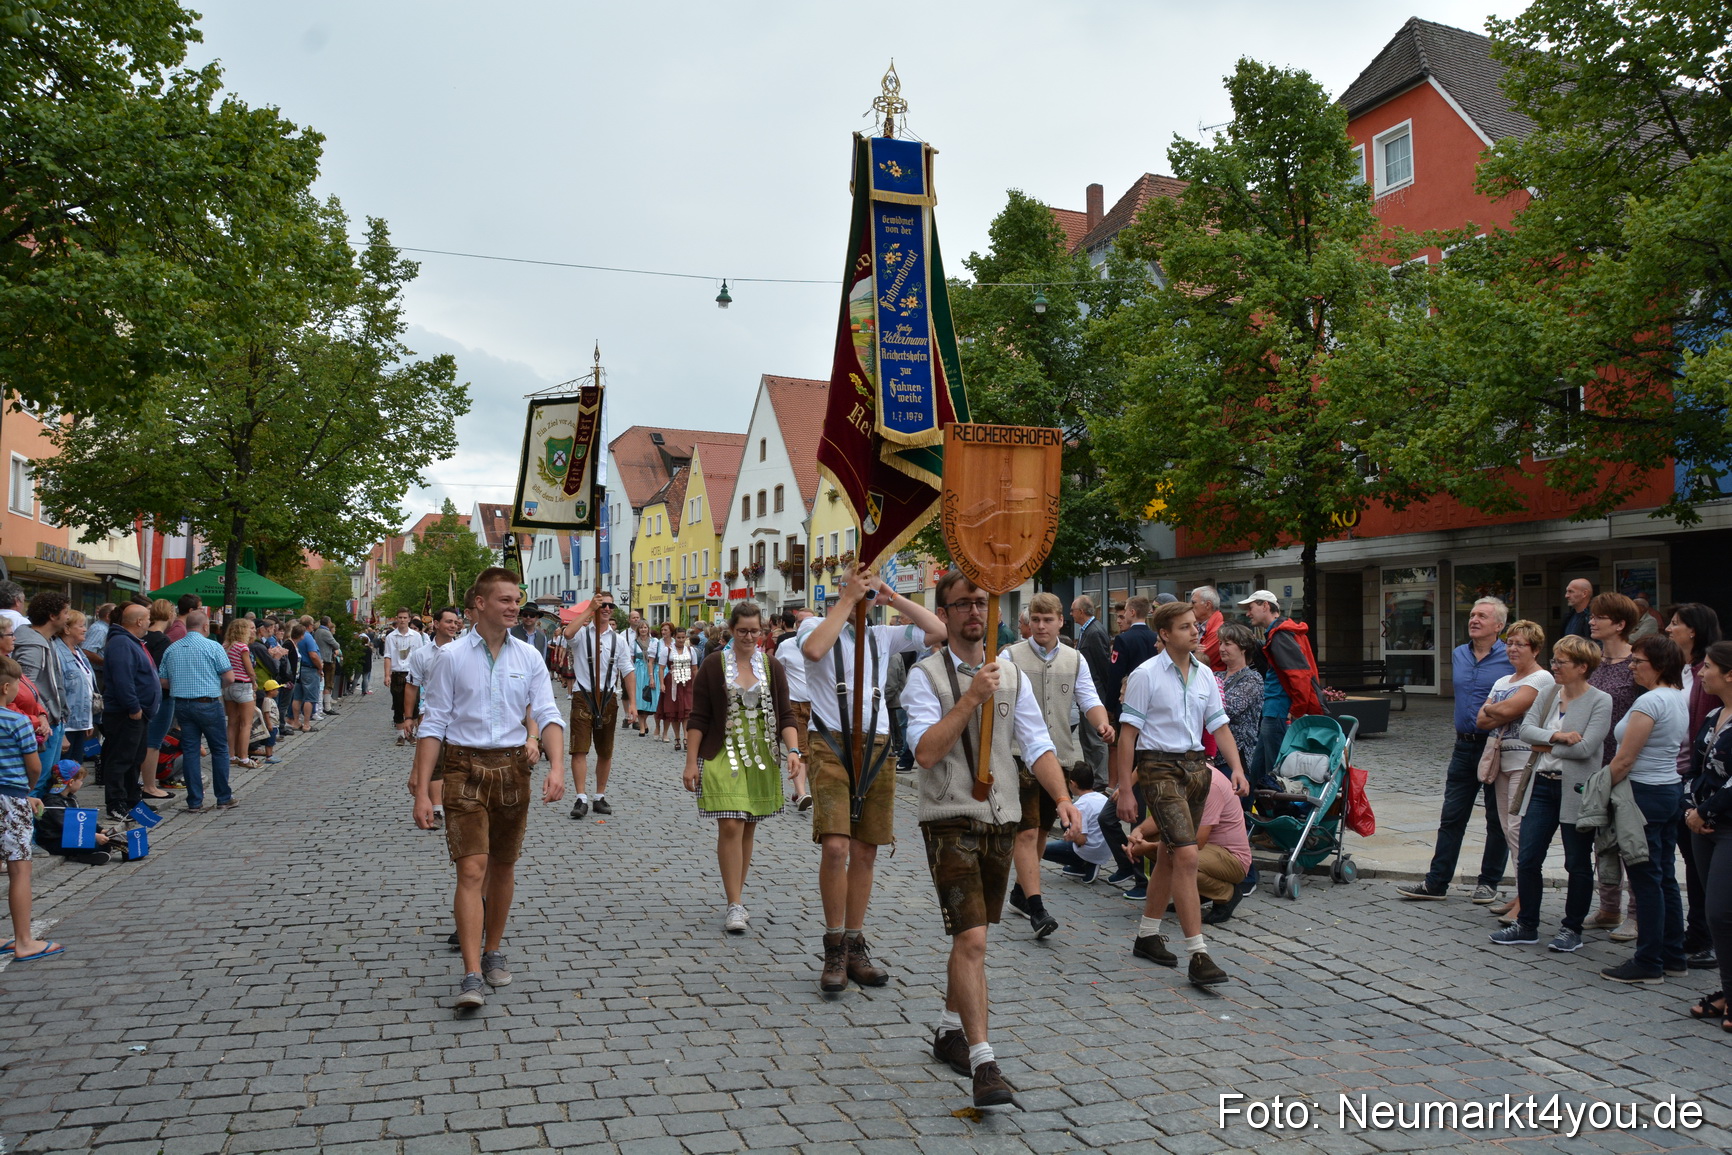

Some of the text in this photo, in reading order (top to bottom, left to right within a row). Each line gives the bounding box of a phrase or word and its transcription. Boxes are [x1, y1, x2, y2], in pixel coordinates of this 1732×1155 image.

[882, 215, 914, 227] Gewidmet
[885, 224, 912, 235] von der
[880, 249, 919, 312] Fahnenbraut
[882, 332, 928, 346] Kellermann
[881, 348, 928, 363] Reichertshofen
[899, 368, 912, 376] zur
[889, 378, 925, 398] Fahnen-
[897, 391, 922, 403] weihe
[547, 418, 558, 429] Ziel
[953, 425, 1061, 446] REICHERTSHOFEN
[943, 489, 1059, 580] Schützenverein Jägerwiesl
